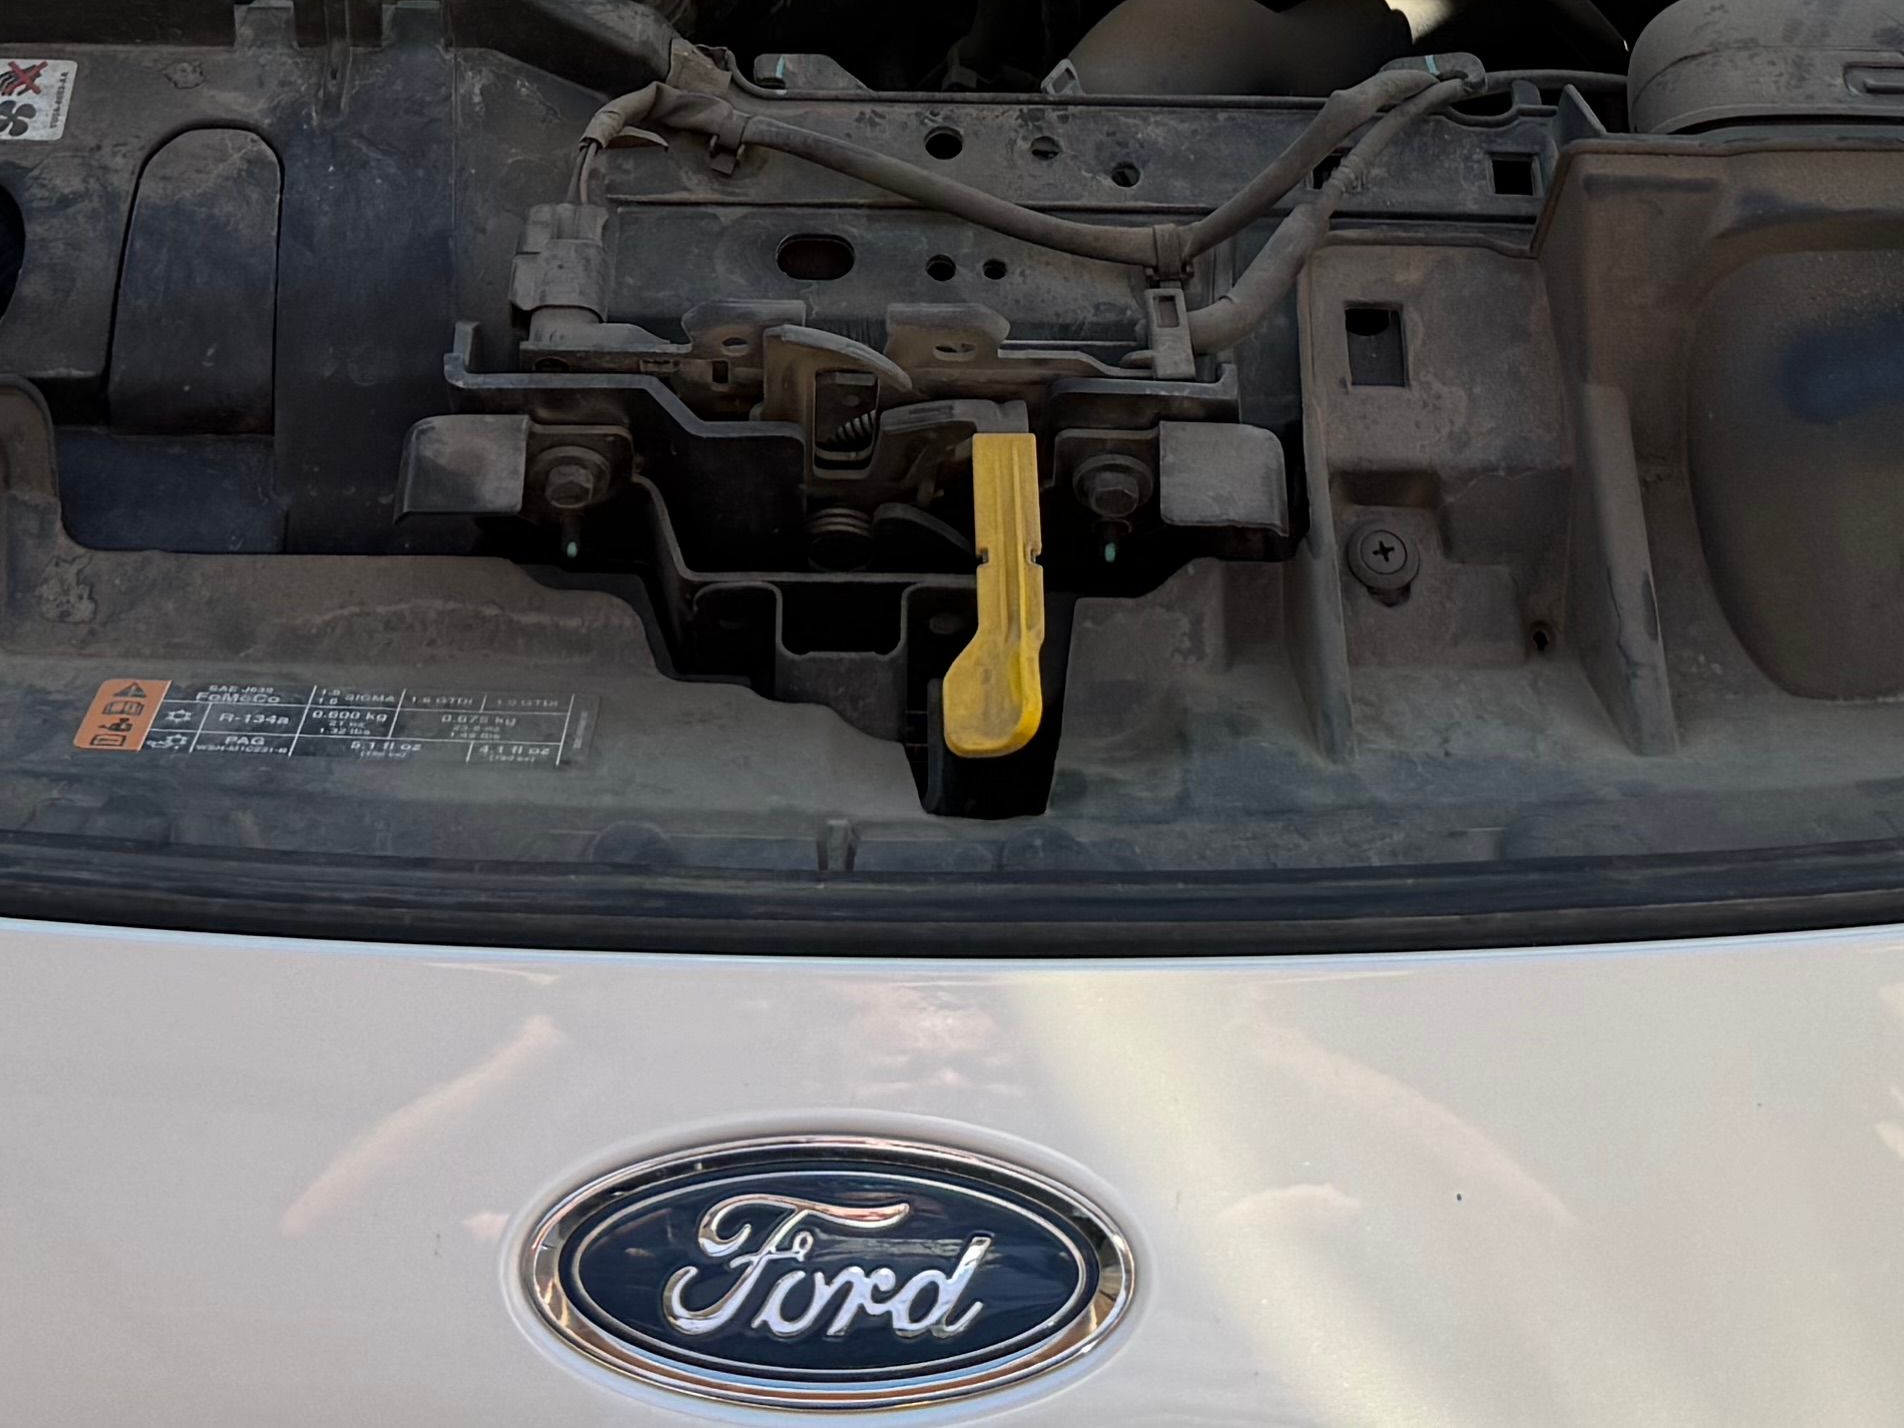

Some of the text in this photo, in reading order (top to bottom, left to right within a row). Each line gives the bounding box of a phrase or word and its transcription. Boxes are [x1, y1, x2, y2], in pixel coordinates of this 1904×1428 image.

[195, 692, 281, 704] FoMoCo
[218, 712, 290, 726] R-134a
[365, 711, 388, 723] kg
[224, 735, 265, 746] PAG
[662, 1193, 994, 1339] Ford
